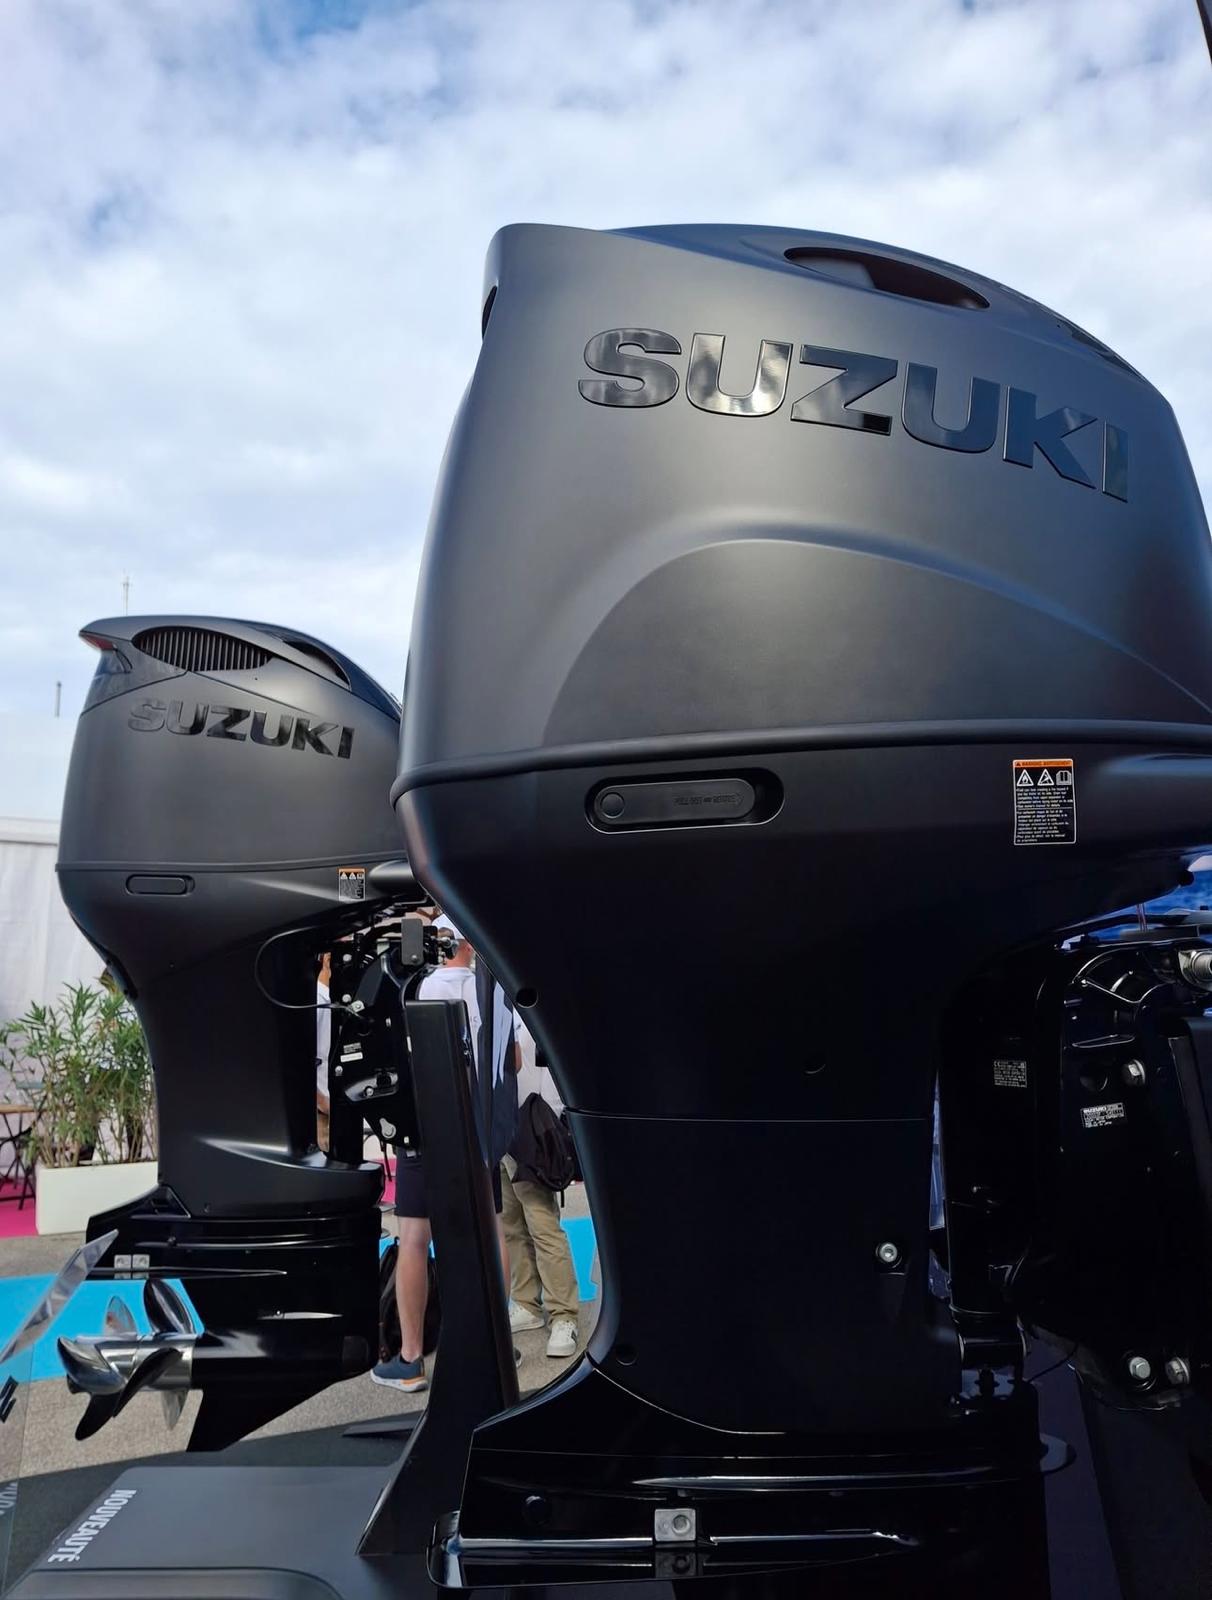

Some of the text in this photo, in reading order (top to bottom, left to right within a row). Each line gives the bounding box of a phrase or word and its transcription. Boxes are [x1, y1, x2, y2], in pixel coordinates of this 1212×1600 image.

[578, 327, 1129, 503] SUZUKI
[128, 699, 355, 760] SUZUKI
[48, 1488, 138, 1563] NOUVEAUTÉ
